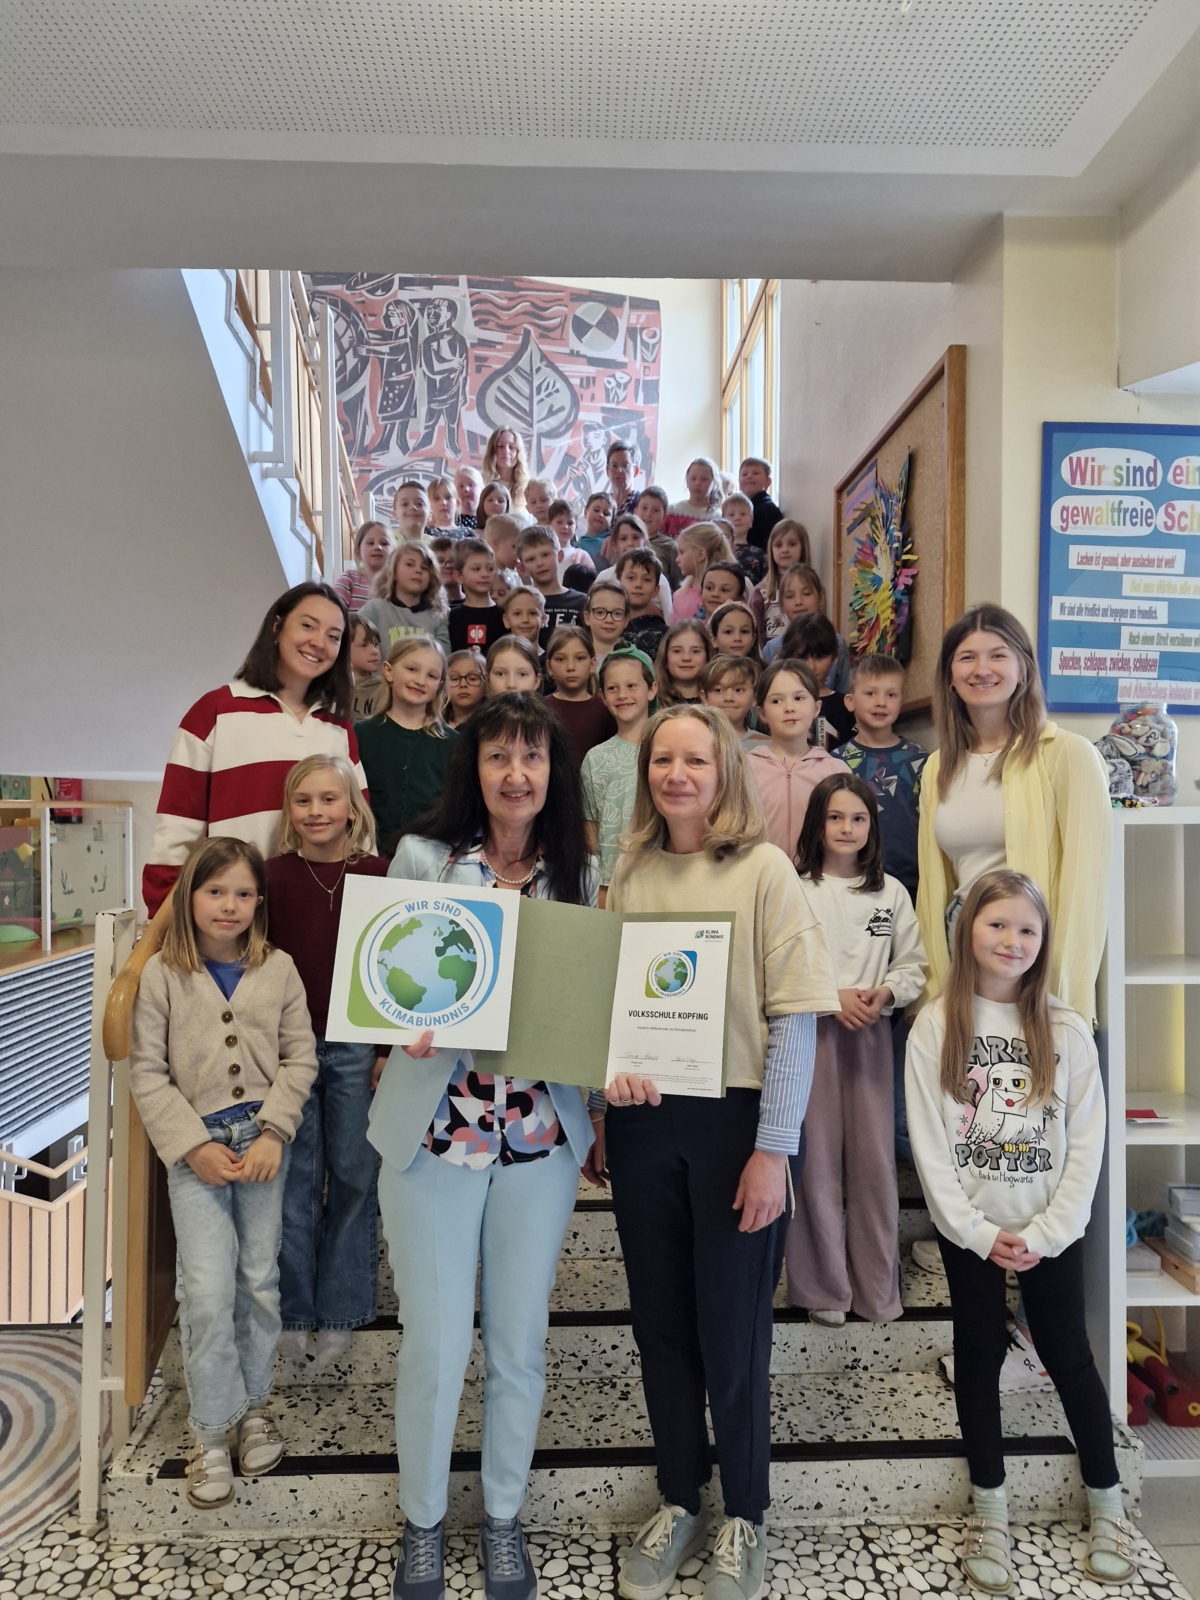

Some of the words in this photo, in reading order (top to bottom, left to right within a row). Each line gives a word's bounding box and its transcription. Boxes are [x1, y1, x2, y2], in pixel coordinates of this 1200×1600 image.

[1068, 456, 1106, 486] Wir
[1113, 458, 1158, 487] sind
[1060, 500, 1154, 532] gewaltfreie
[1077, 552, 1093, 566] Lachen
[1059, 602, 1067, 616] Wir
[1067, 602, 1076, 617] sind
[1059, 651, 1082, 675] Spucken,
[1083, 652, 1108, 676] schlagen,
[1108, 652, 1132, 676] zwicken,
[1132, 653, 1158, 673] schubsen
[1119, 682, 1132, 698] und
[404, 900, 429, 914] WIR
[433, 901, 461, 917] SIND
[378, 998, 470, 1027] KLIMABÜNDNIS
[628, 1010, 676, 1020] VOLKSSCHULE
[677, 1012, 709, 1021] KOPFING
[955, 1143, 1053, 1173] POTTER
[978, 1172, 991, 1181] Back
[1000, 1172, 1034, 1188] Hogwarts
